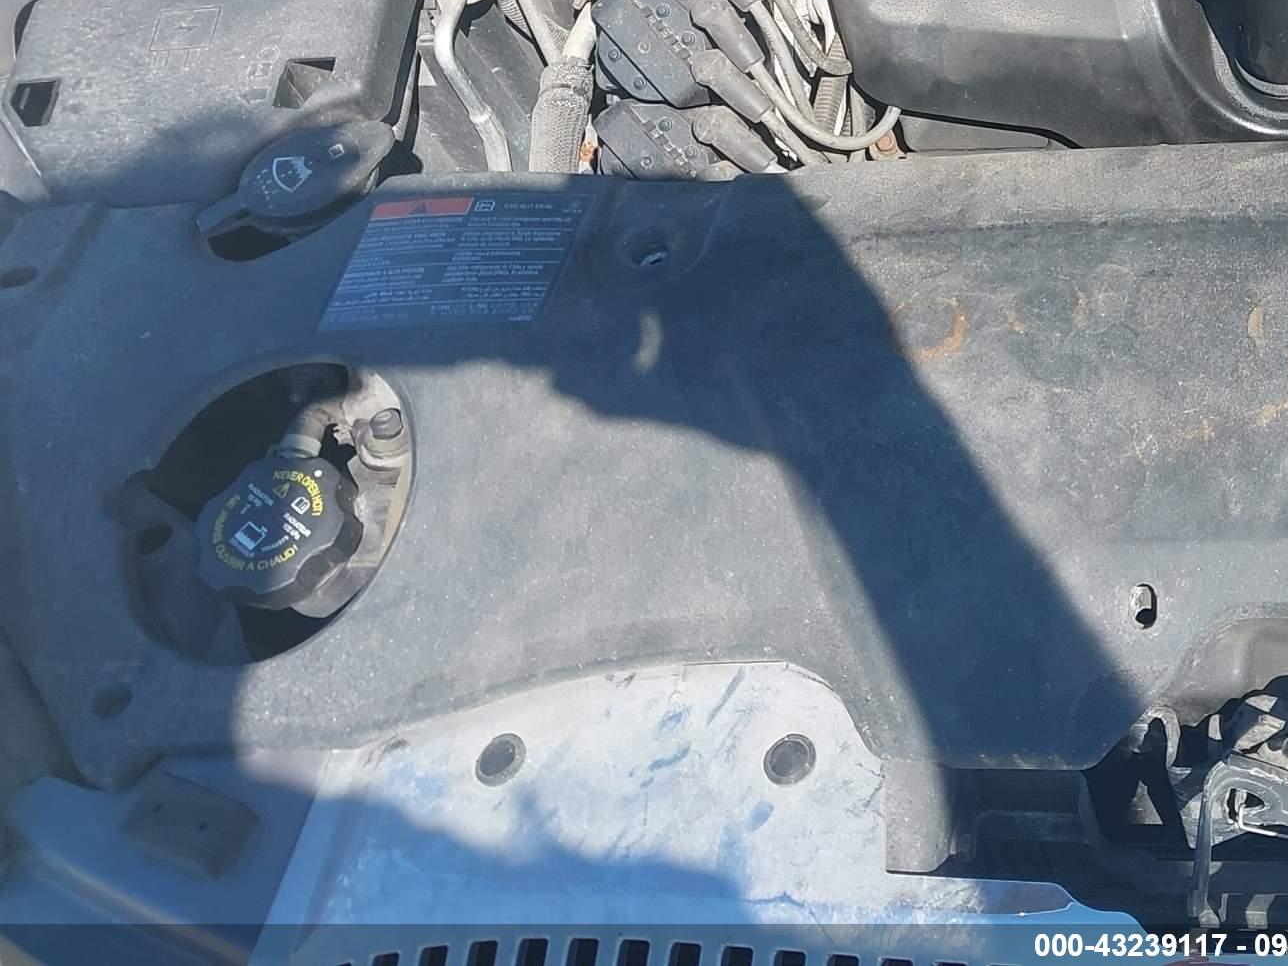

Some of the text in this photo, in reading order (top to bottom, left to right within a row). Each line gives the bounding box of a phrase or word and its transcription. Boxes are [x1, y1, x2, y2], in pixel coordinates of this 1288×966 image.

[272, 469, 304, 483] NEVER
[301, 475, 321, 497] OPEN
[257, 544, 299, 571] CHAUD!
